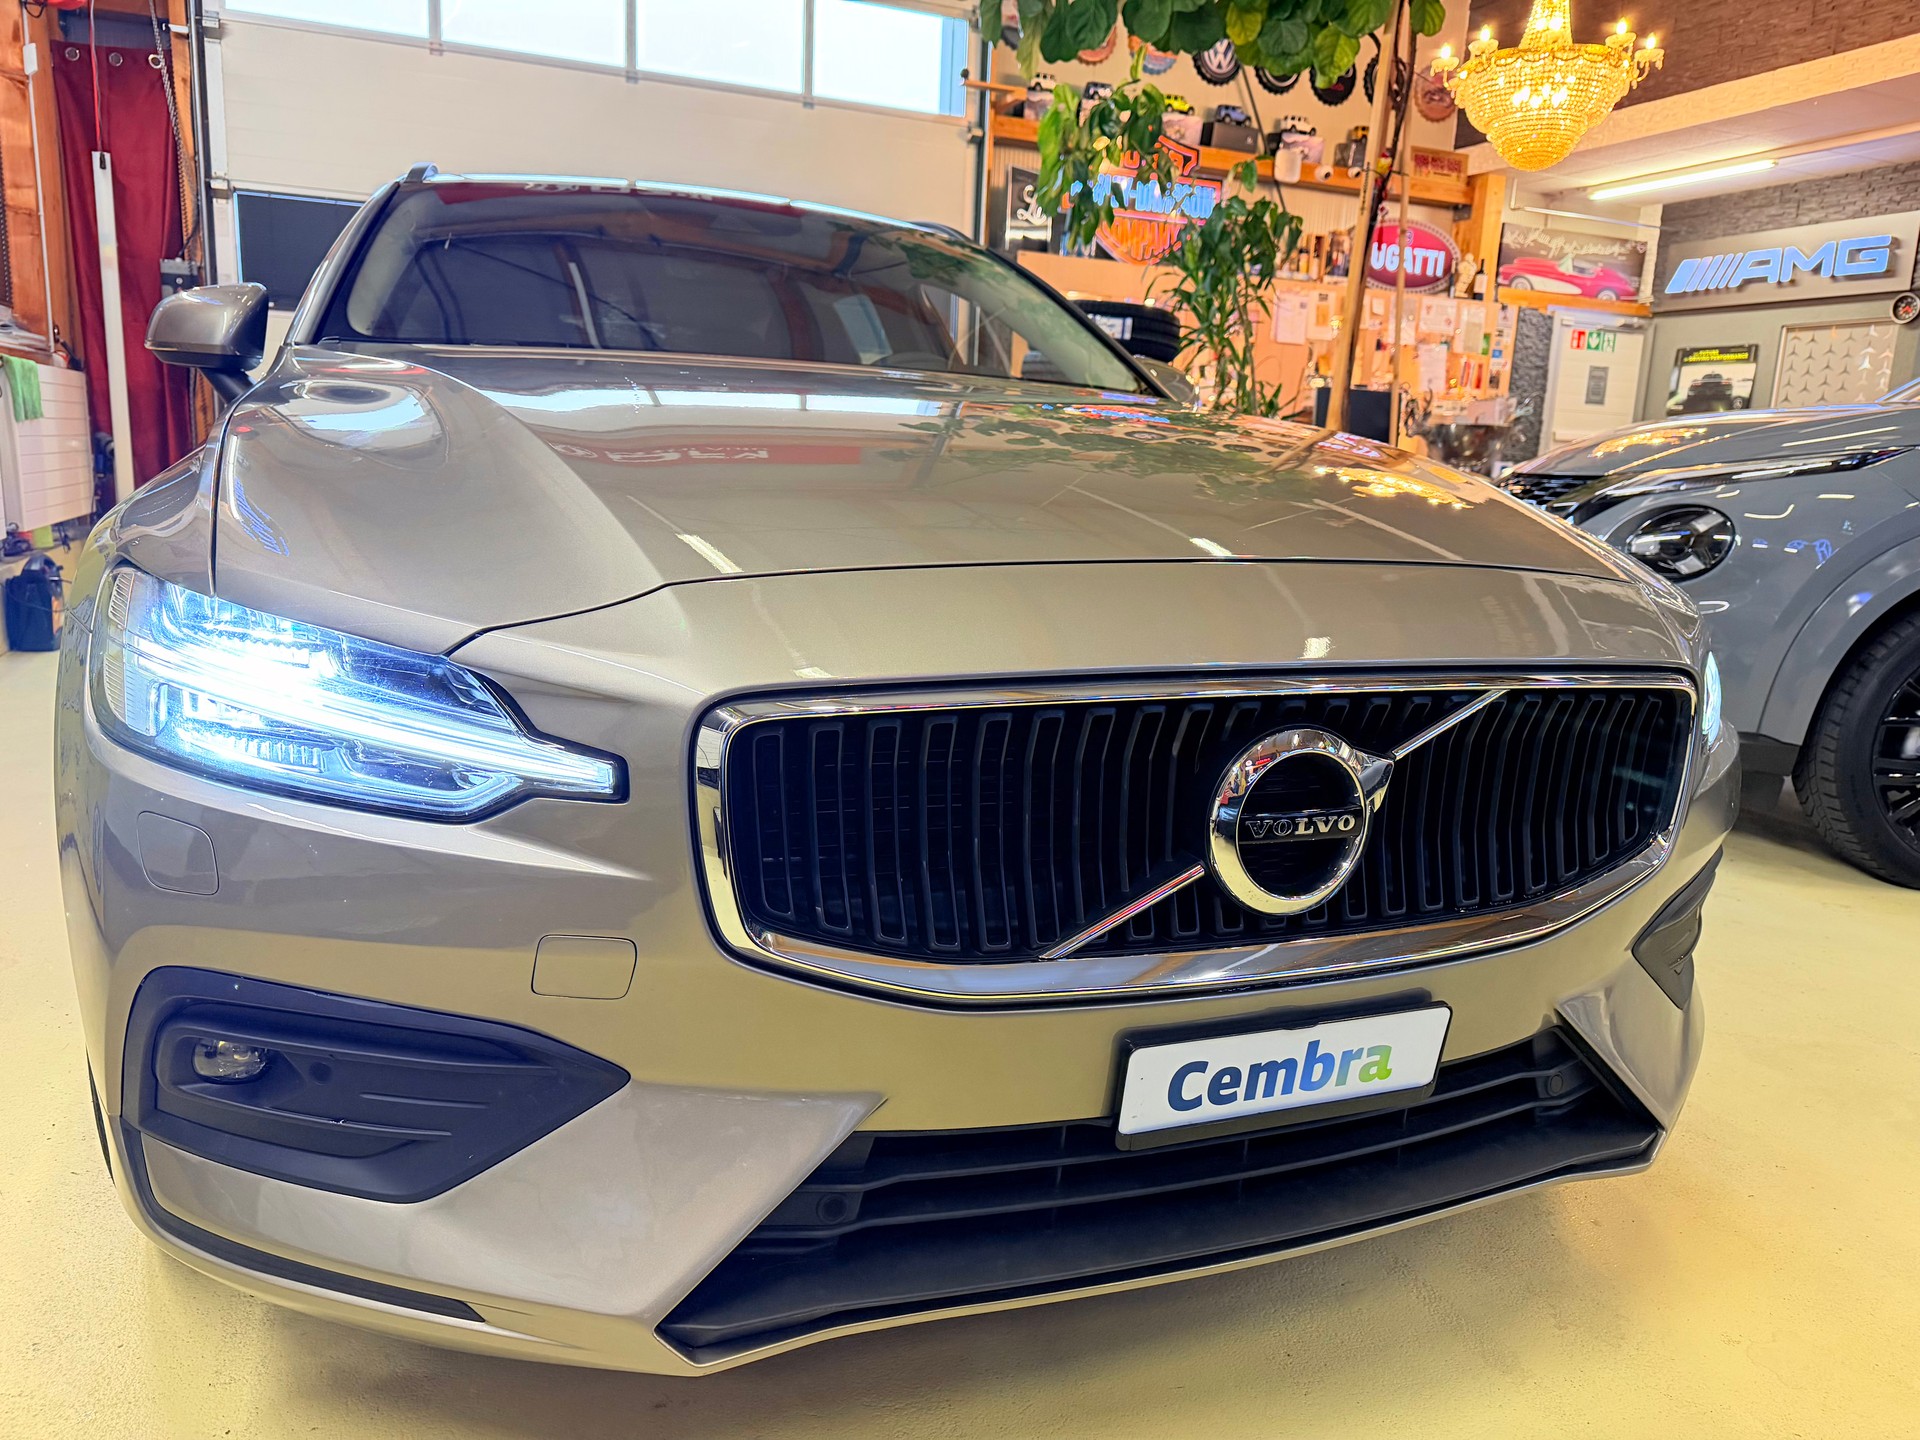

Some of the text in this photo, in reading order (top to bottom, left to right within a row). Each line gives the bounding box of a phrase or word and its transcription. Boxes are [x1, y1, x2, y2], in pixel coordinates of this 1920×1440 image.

[1370, 241, 1446, 278] UGATTI
[1245, 814, 1356, 838] VOLVO
[1167, 1039, 1393, 1112] Cembra
